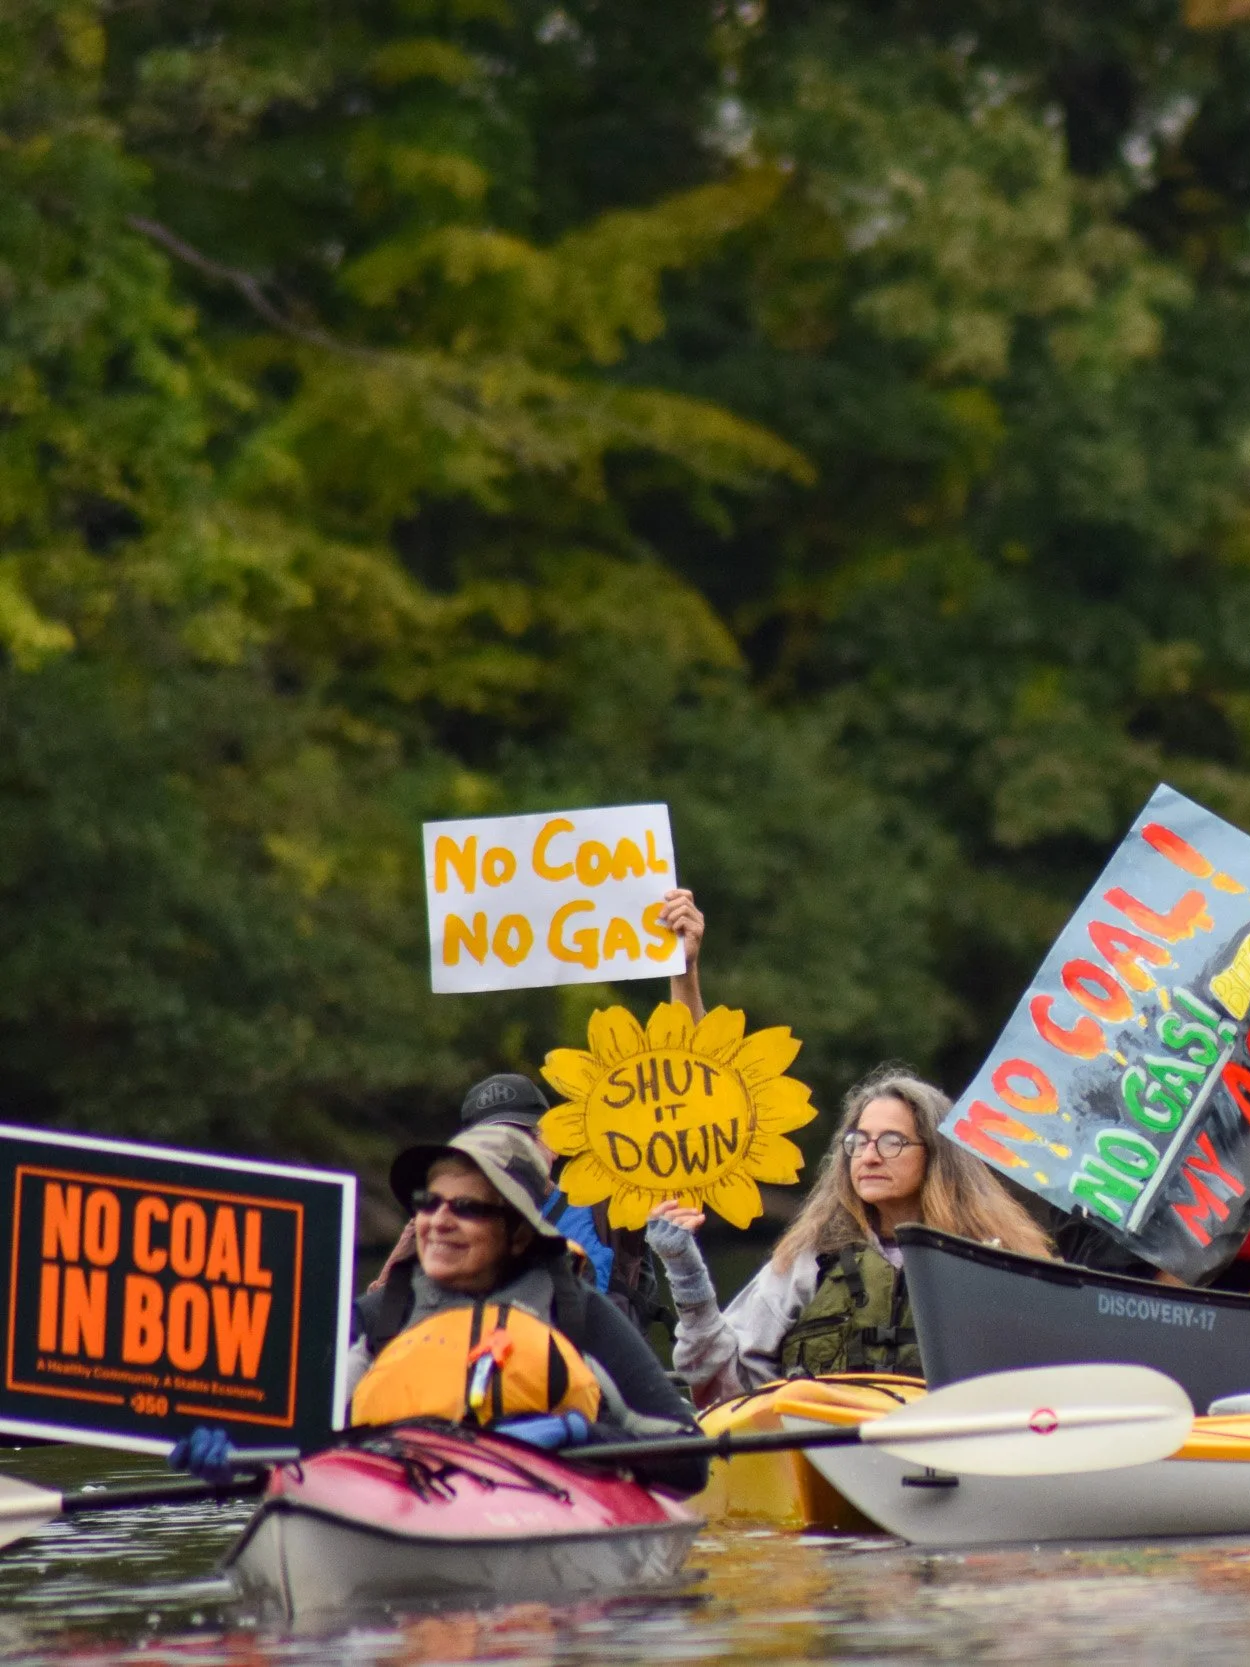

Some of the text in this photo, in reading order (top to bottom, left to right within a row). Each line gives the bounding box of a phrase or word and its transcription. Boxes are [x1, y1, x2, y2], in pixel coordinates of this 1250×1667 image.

[443, 900, 678, 970] NO GAS
[602, 1058, 720, 1109] SHUT
[655, 1103, 686, 1123] IT
[953, 1058, 1062, 1172] NO
[1069, 987, 1238, 1223] NO GAS!
[605, 1117, 739, 1178] DOWN
[1172, 1132, 1246, 1247] MY
[42, 1182, 273, 1288] NO COAL
[38, 1263, 272, 1379] IN BOW
[1099, 1294, 1217, 1331] DISCOVERY-17
